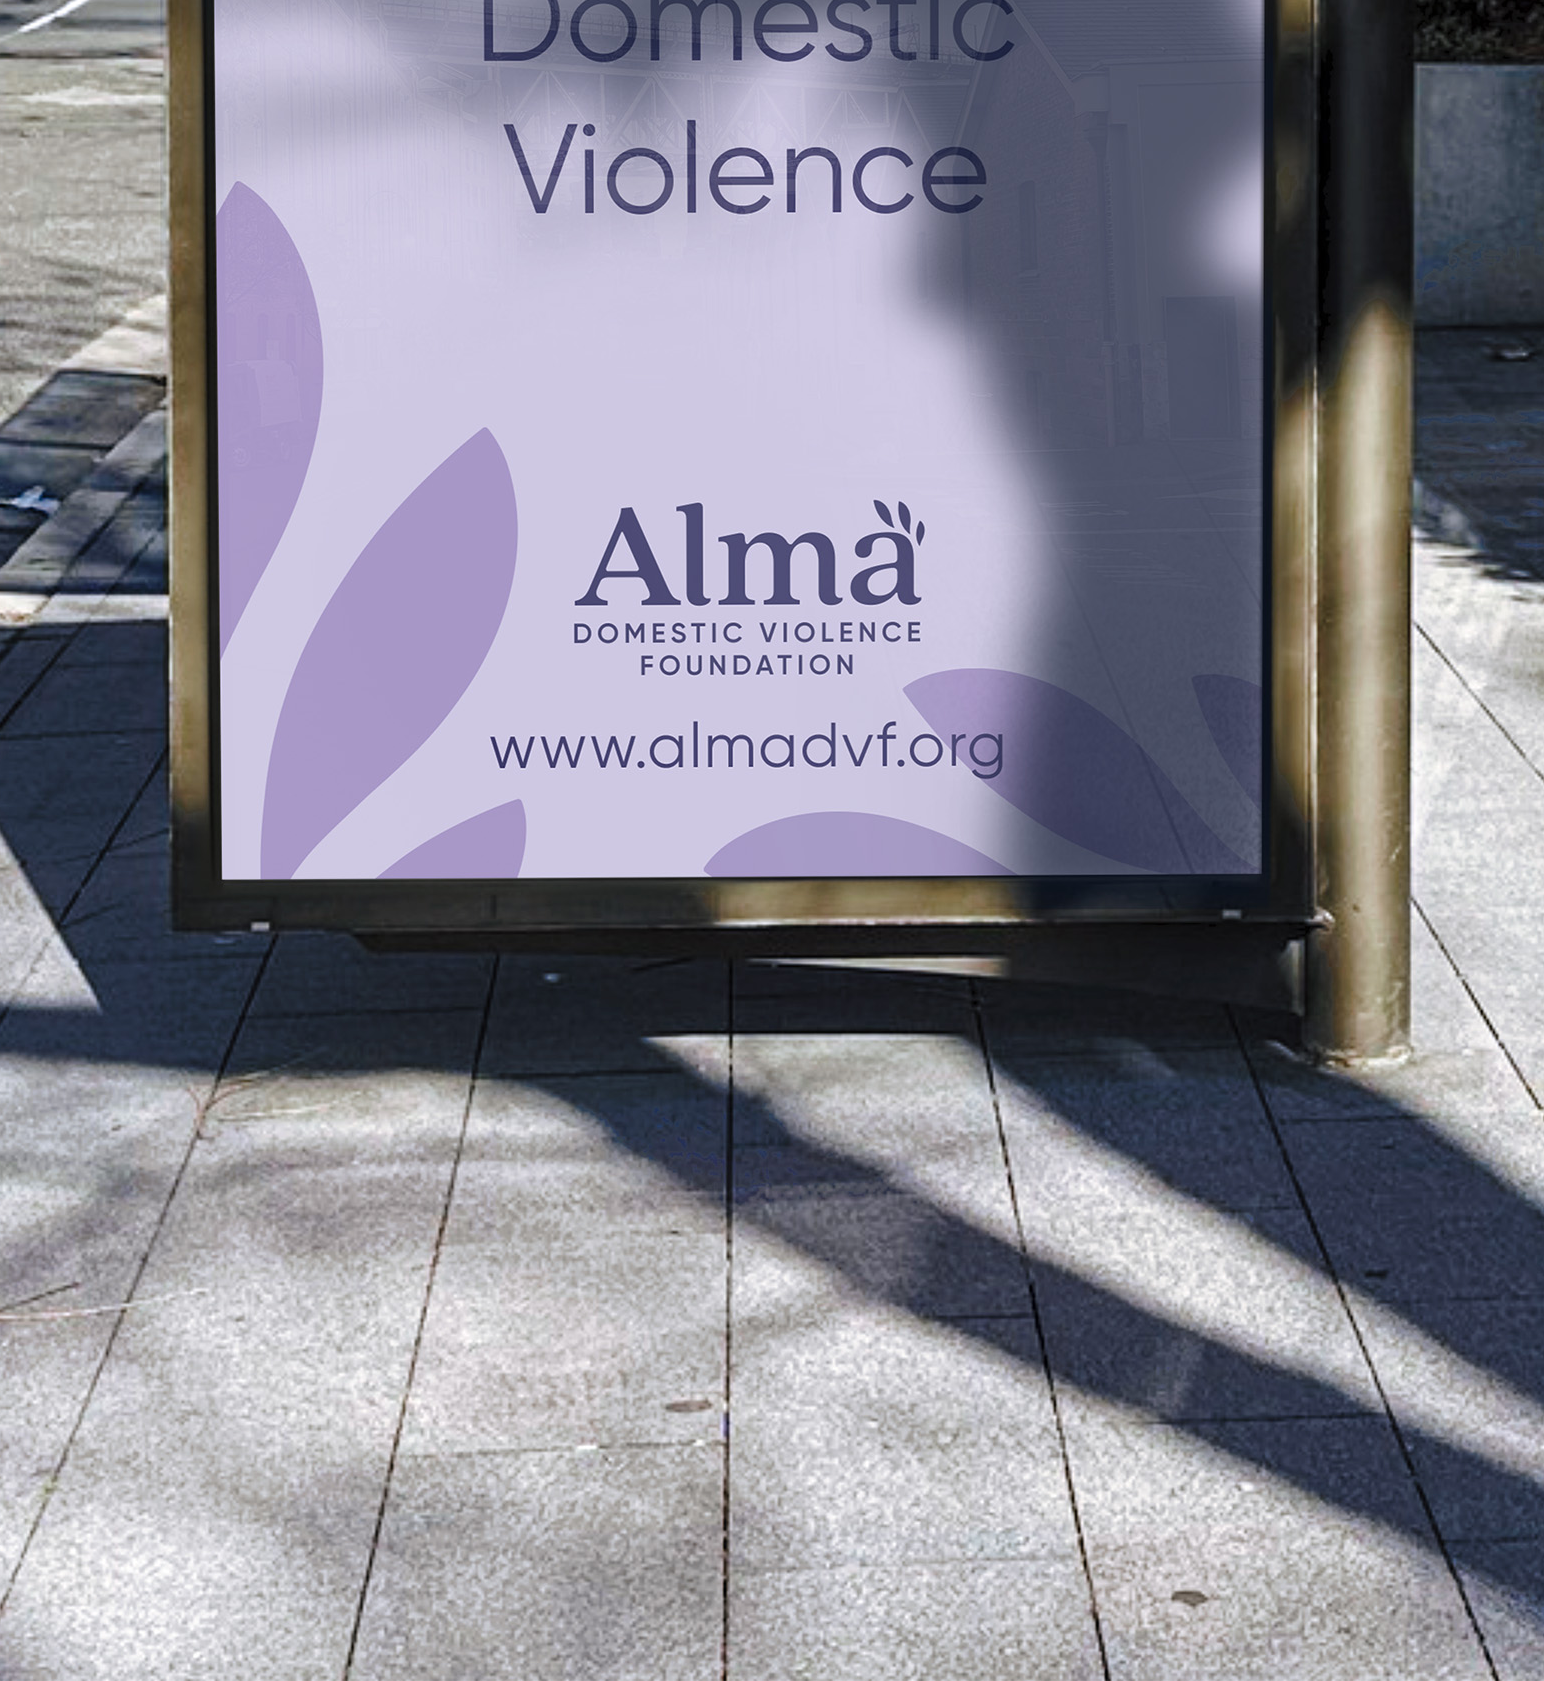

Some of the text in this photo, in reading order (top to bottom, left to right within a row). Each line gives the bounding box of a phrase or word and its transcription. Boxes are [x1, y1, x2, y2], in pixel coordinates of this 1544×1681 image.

[502, 119, 988, 215] Violence
[574, 501, 924, 607] Alma
[573, 620, 923, 645] DOMESTIC VIOLENCE
[640, 653, 855, 677] FOUNDATION
[489, 720, 1005, 780] www.almadvf.org
